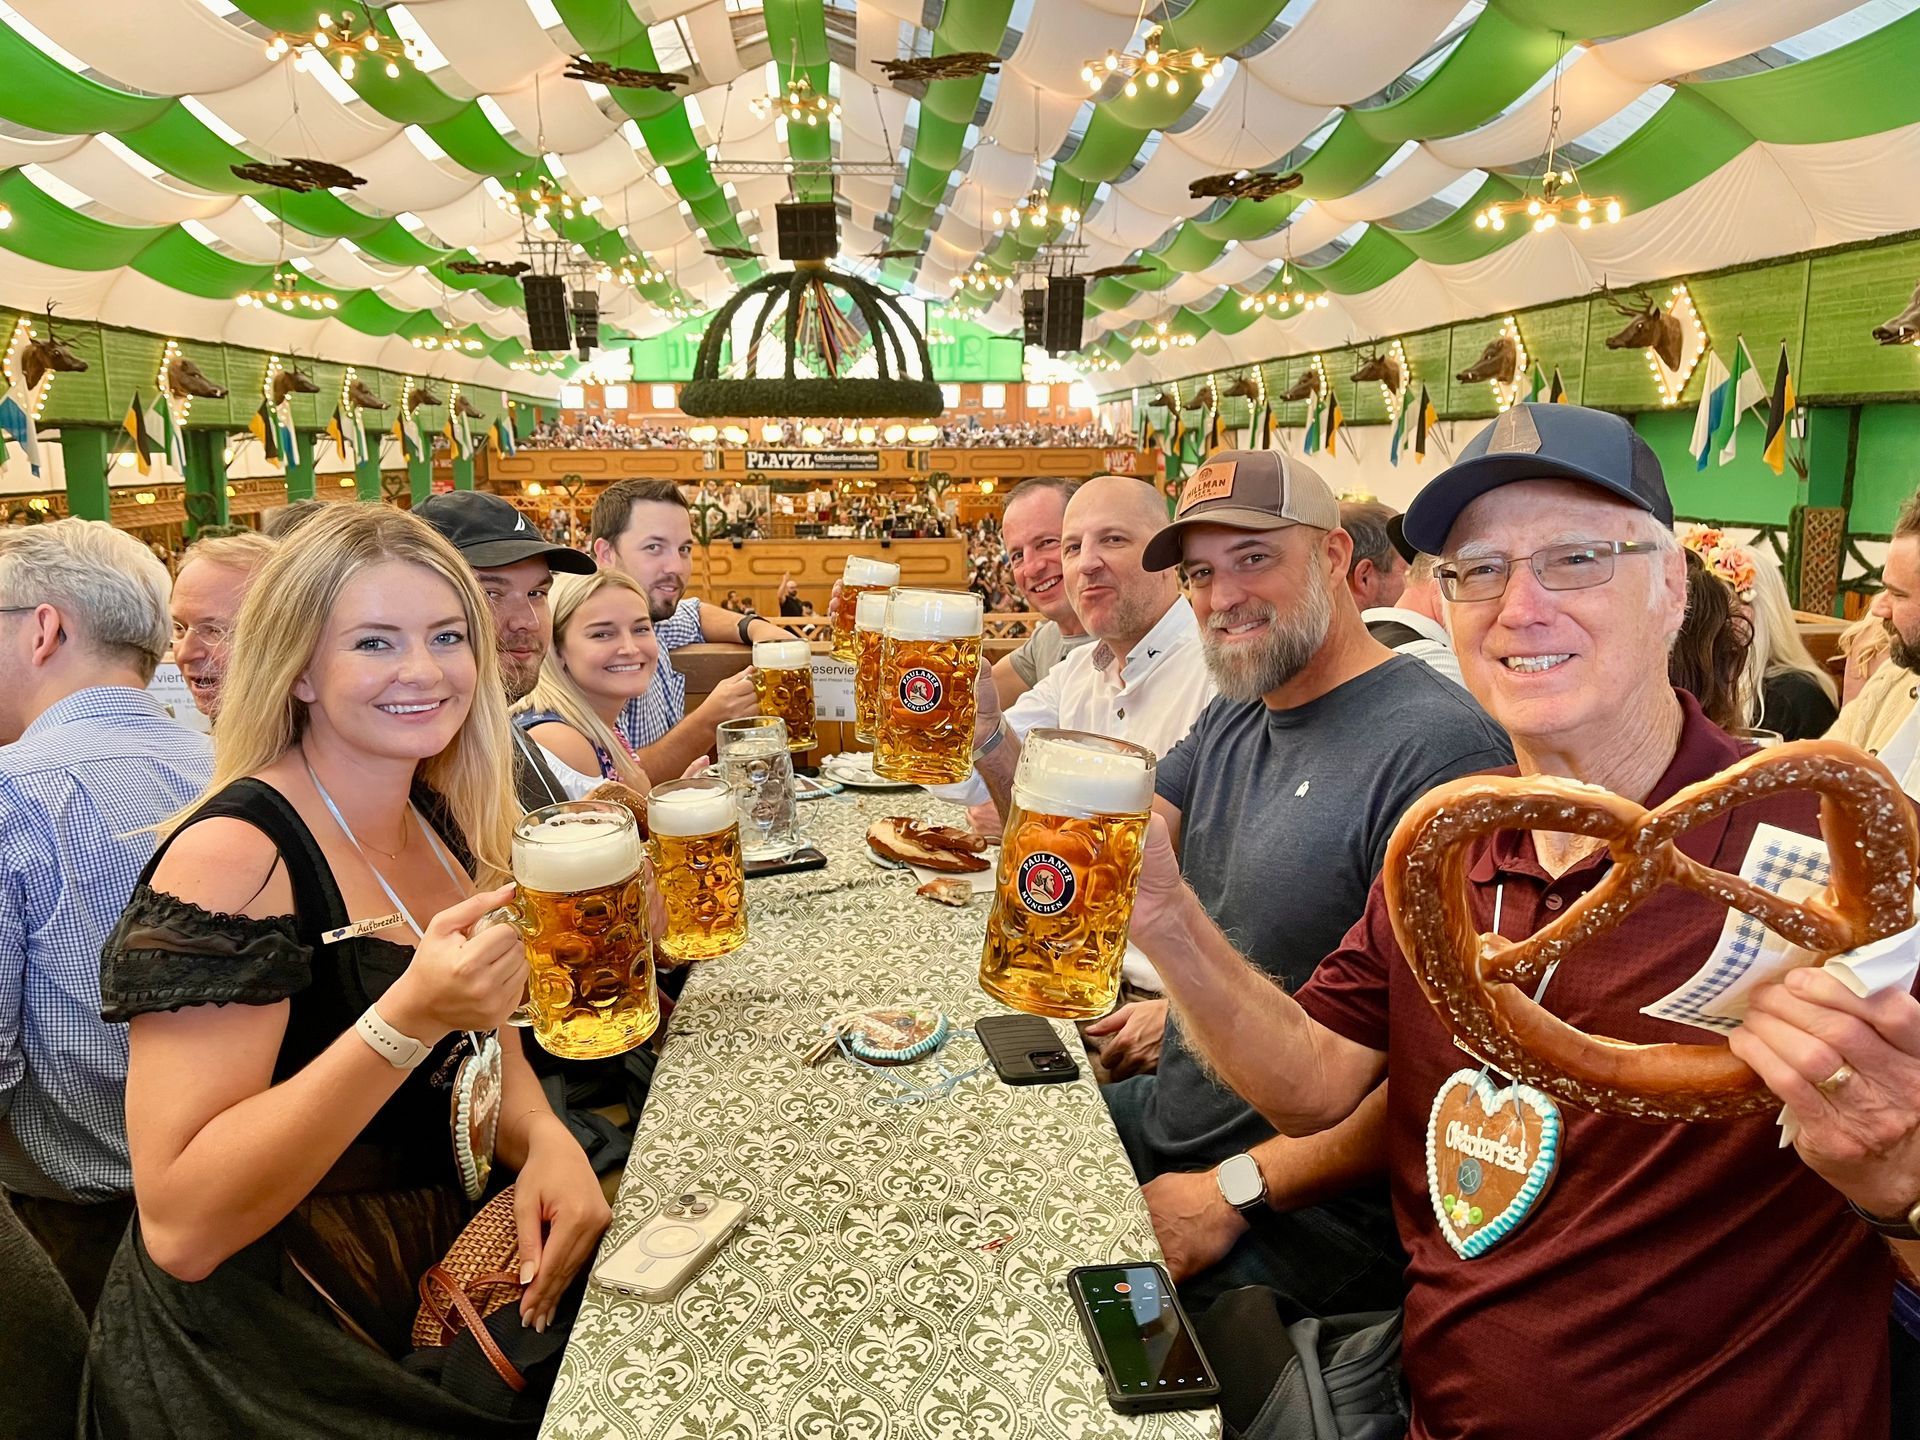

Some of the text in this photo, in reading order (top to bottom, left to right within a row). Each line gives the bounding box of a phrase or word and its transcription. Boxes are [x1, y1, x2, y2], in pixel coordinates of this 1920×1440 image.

[746, 451, 815, 469] PLATZL
[1186, 478, 1226, 500] HILLMAN
[811, 664, 856, 675] eservie
[902, 670, 940, 688] PAULANER
[1023, 854, 1073, 883] PAULANER
[356, 912, 404, 934] Aufbrezelt!
[1445, 1120, 1528, 1175] Oktoberfest
